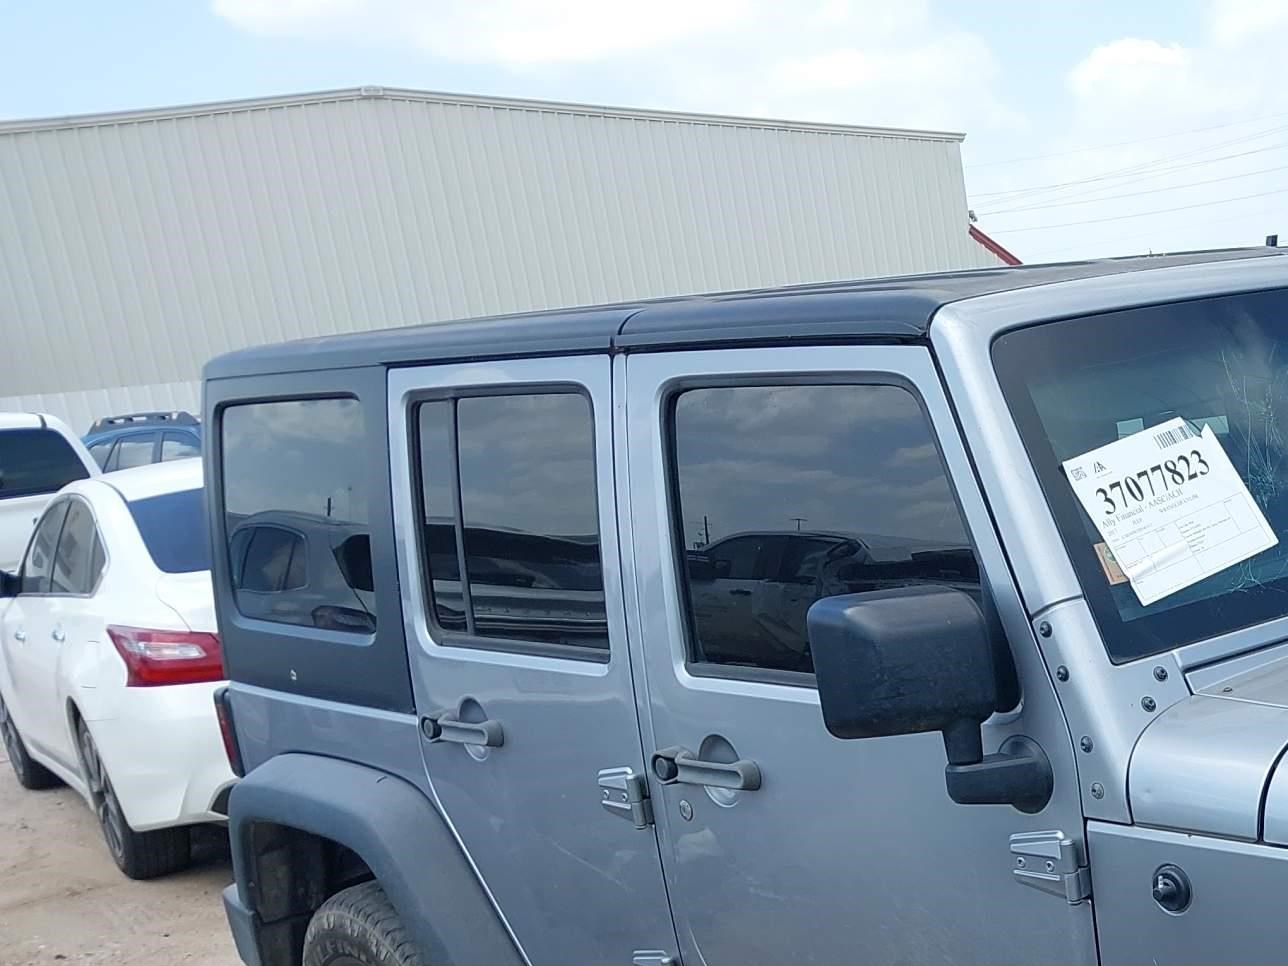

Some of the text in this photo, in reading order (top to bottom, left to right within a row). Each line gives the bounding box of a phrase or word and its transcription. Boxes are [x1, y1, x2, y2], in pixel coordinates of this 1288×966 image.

[1095, 449, 1210, 515] 37077823
[1102, 515, 1117, 529] Ally
[1115, 504, 1144, 521] Financial
